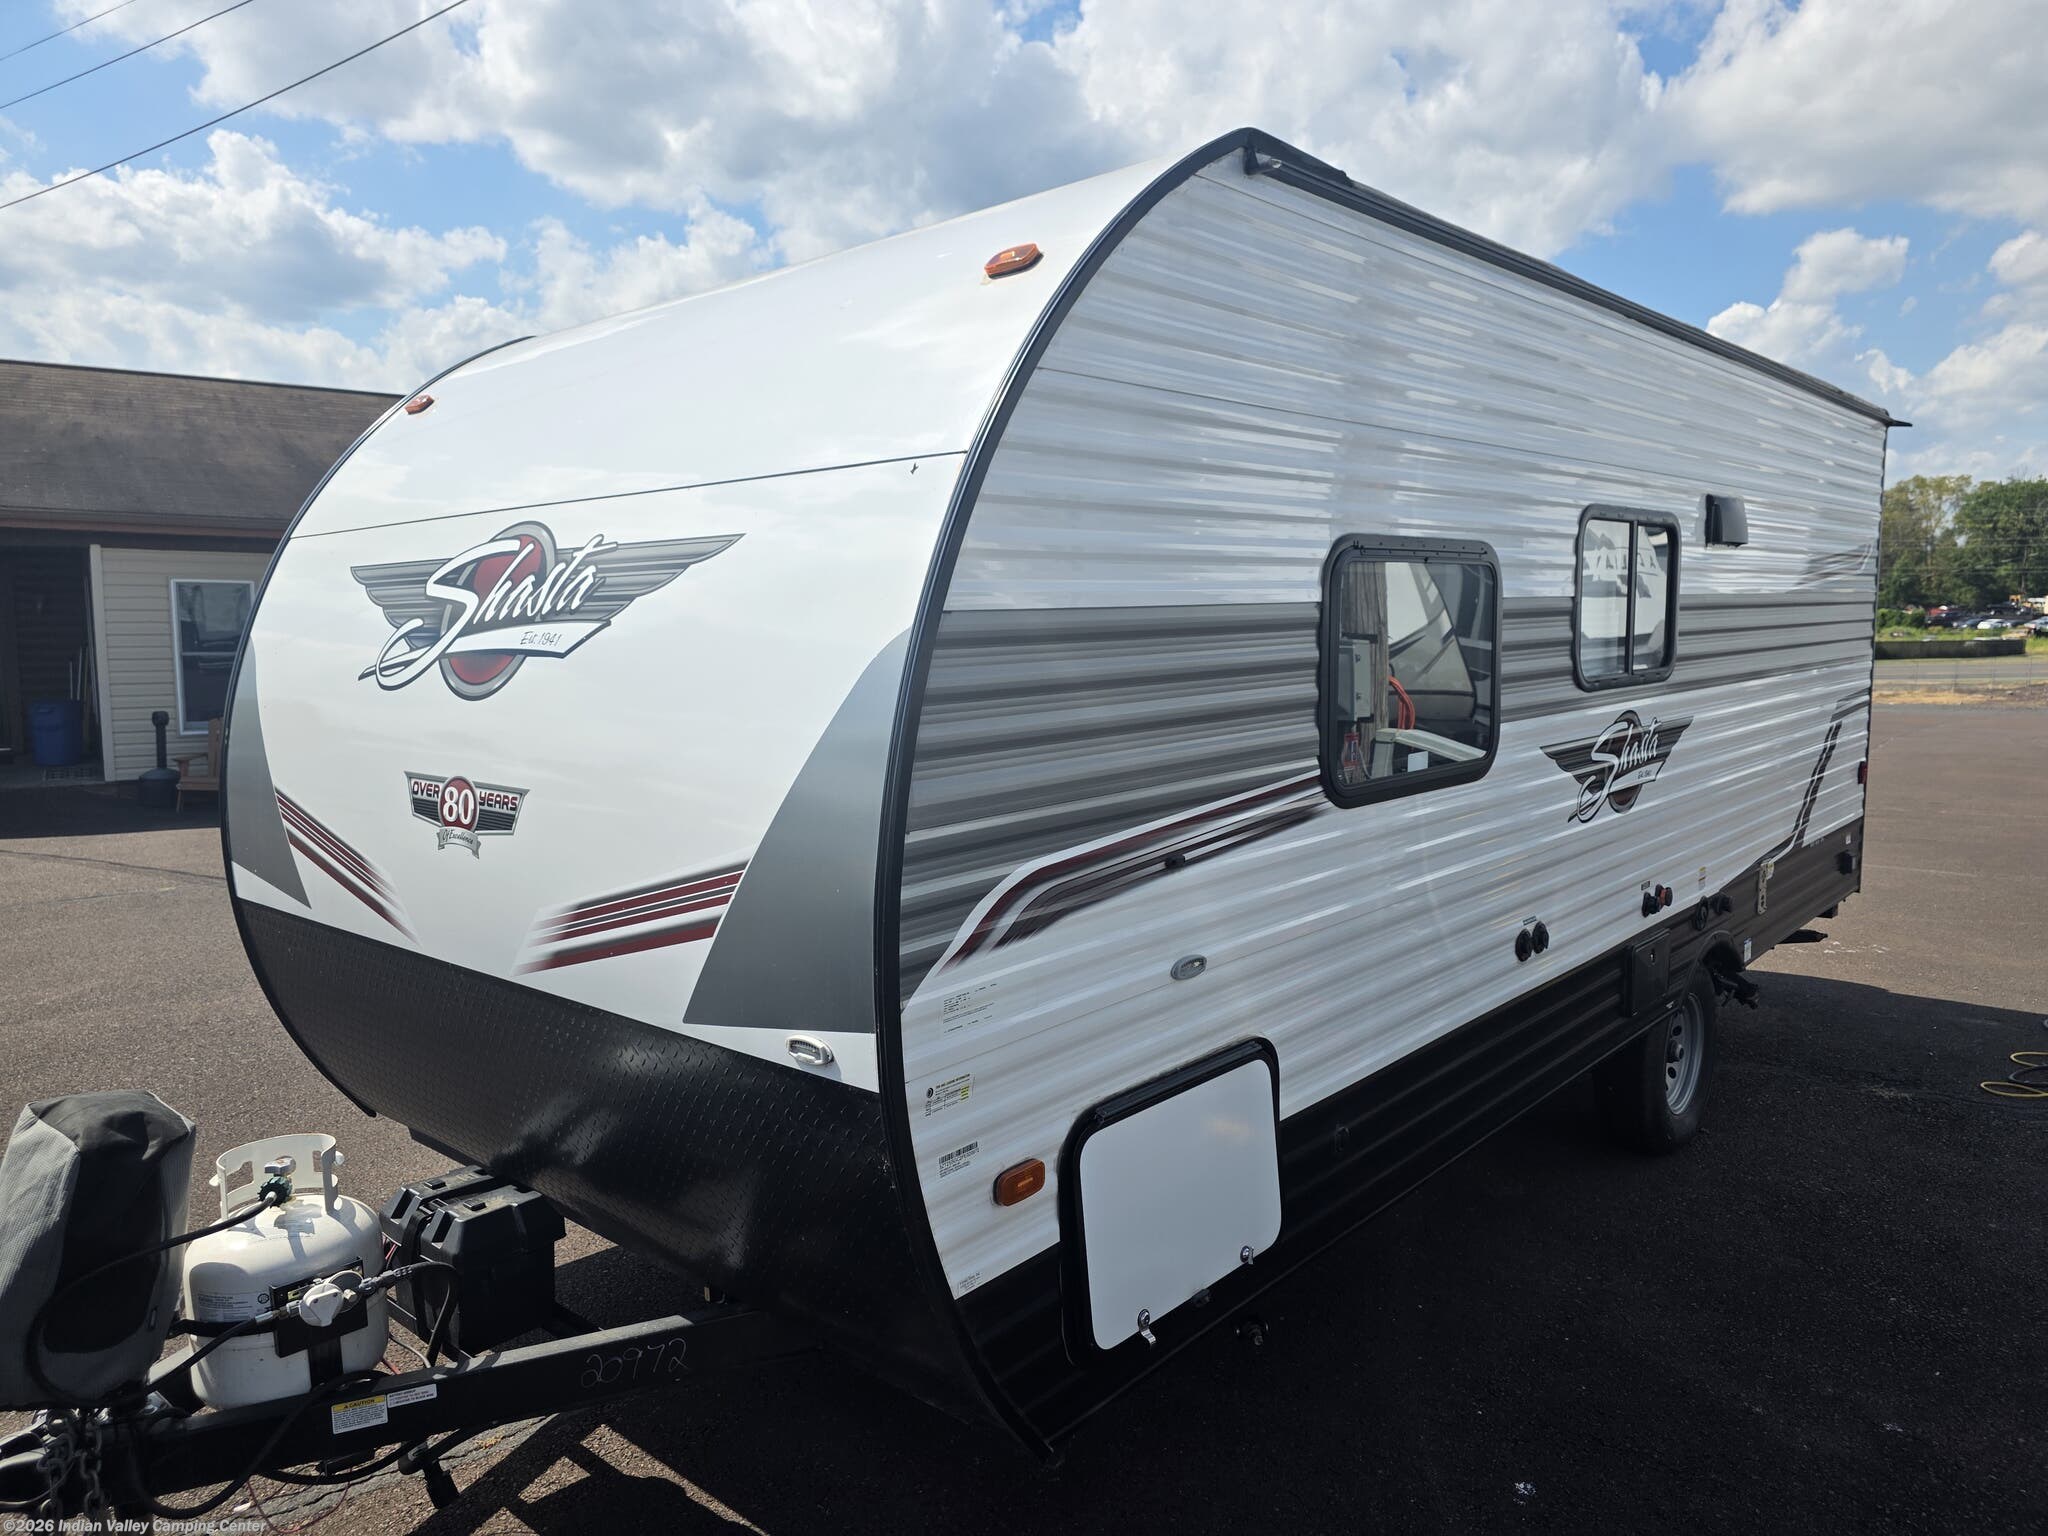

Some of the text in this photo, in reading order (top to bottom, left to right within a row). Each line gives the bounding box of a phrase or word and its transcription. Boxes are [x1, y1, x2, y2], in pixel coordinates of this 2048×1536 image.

[376, 534, 618, 690] Shasta
[538, 631, 563, 647] 1941
[1577, 717, 1661, 823] Shasta
[412, 780, 518, 825] OVER 80 YEARS
[581, 1337, 690, 1388] 20972
[348, 1398, 375, 1409] CAUTION
